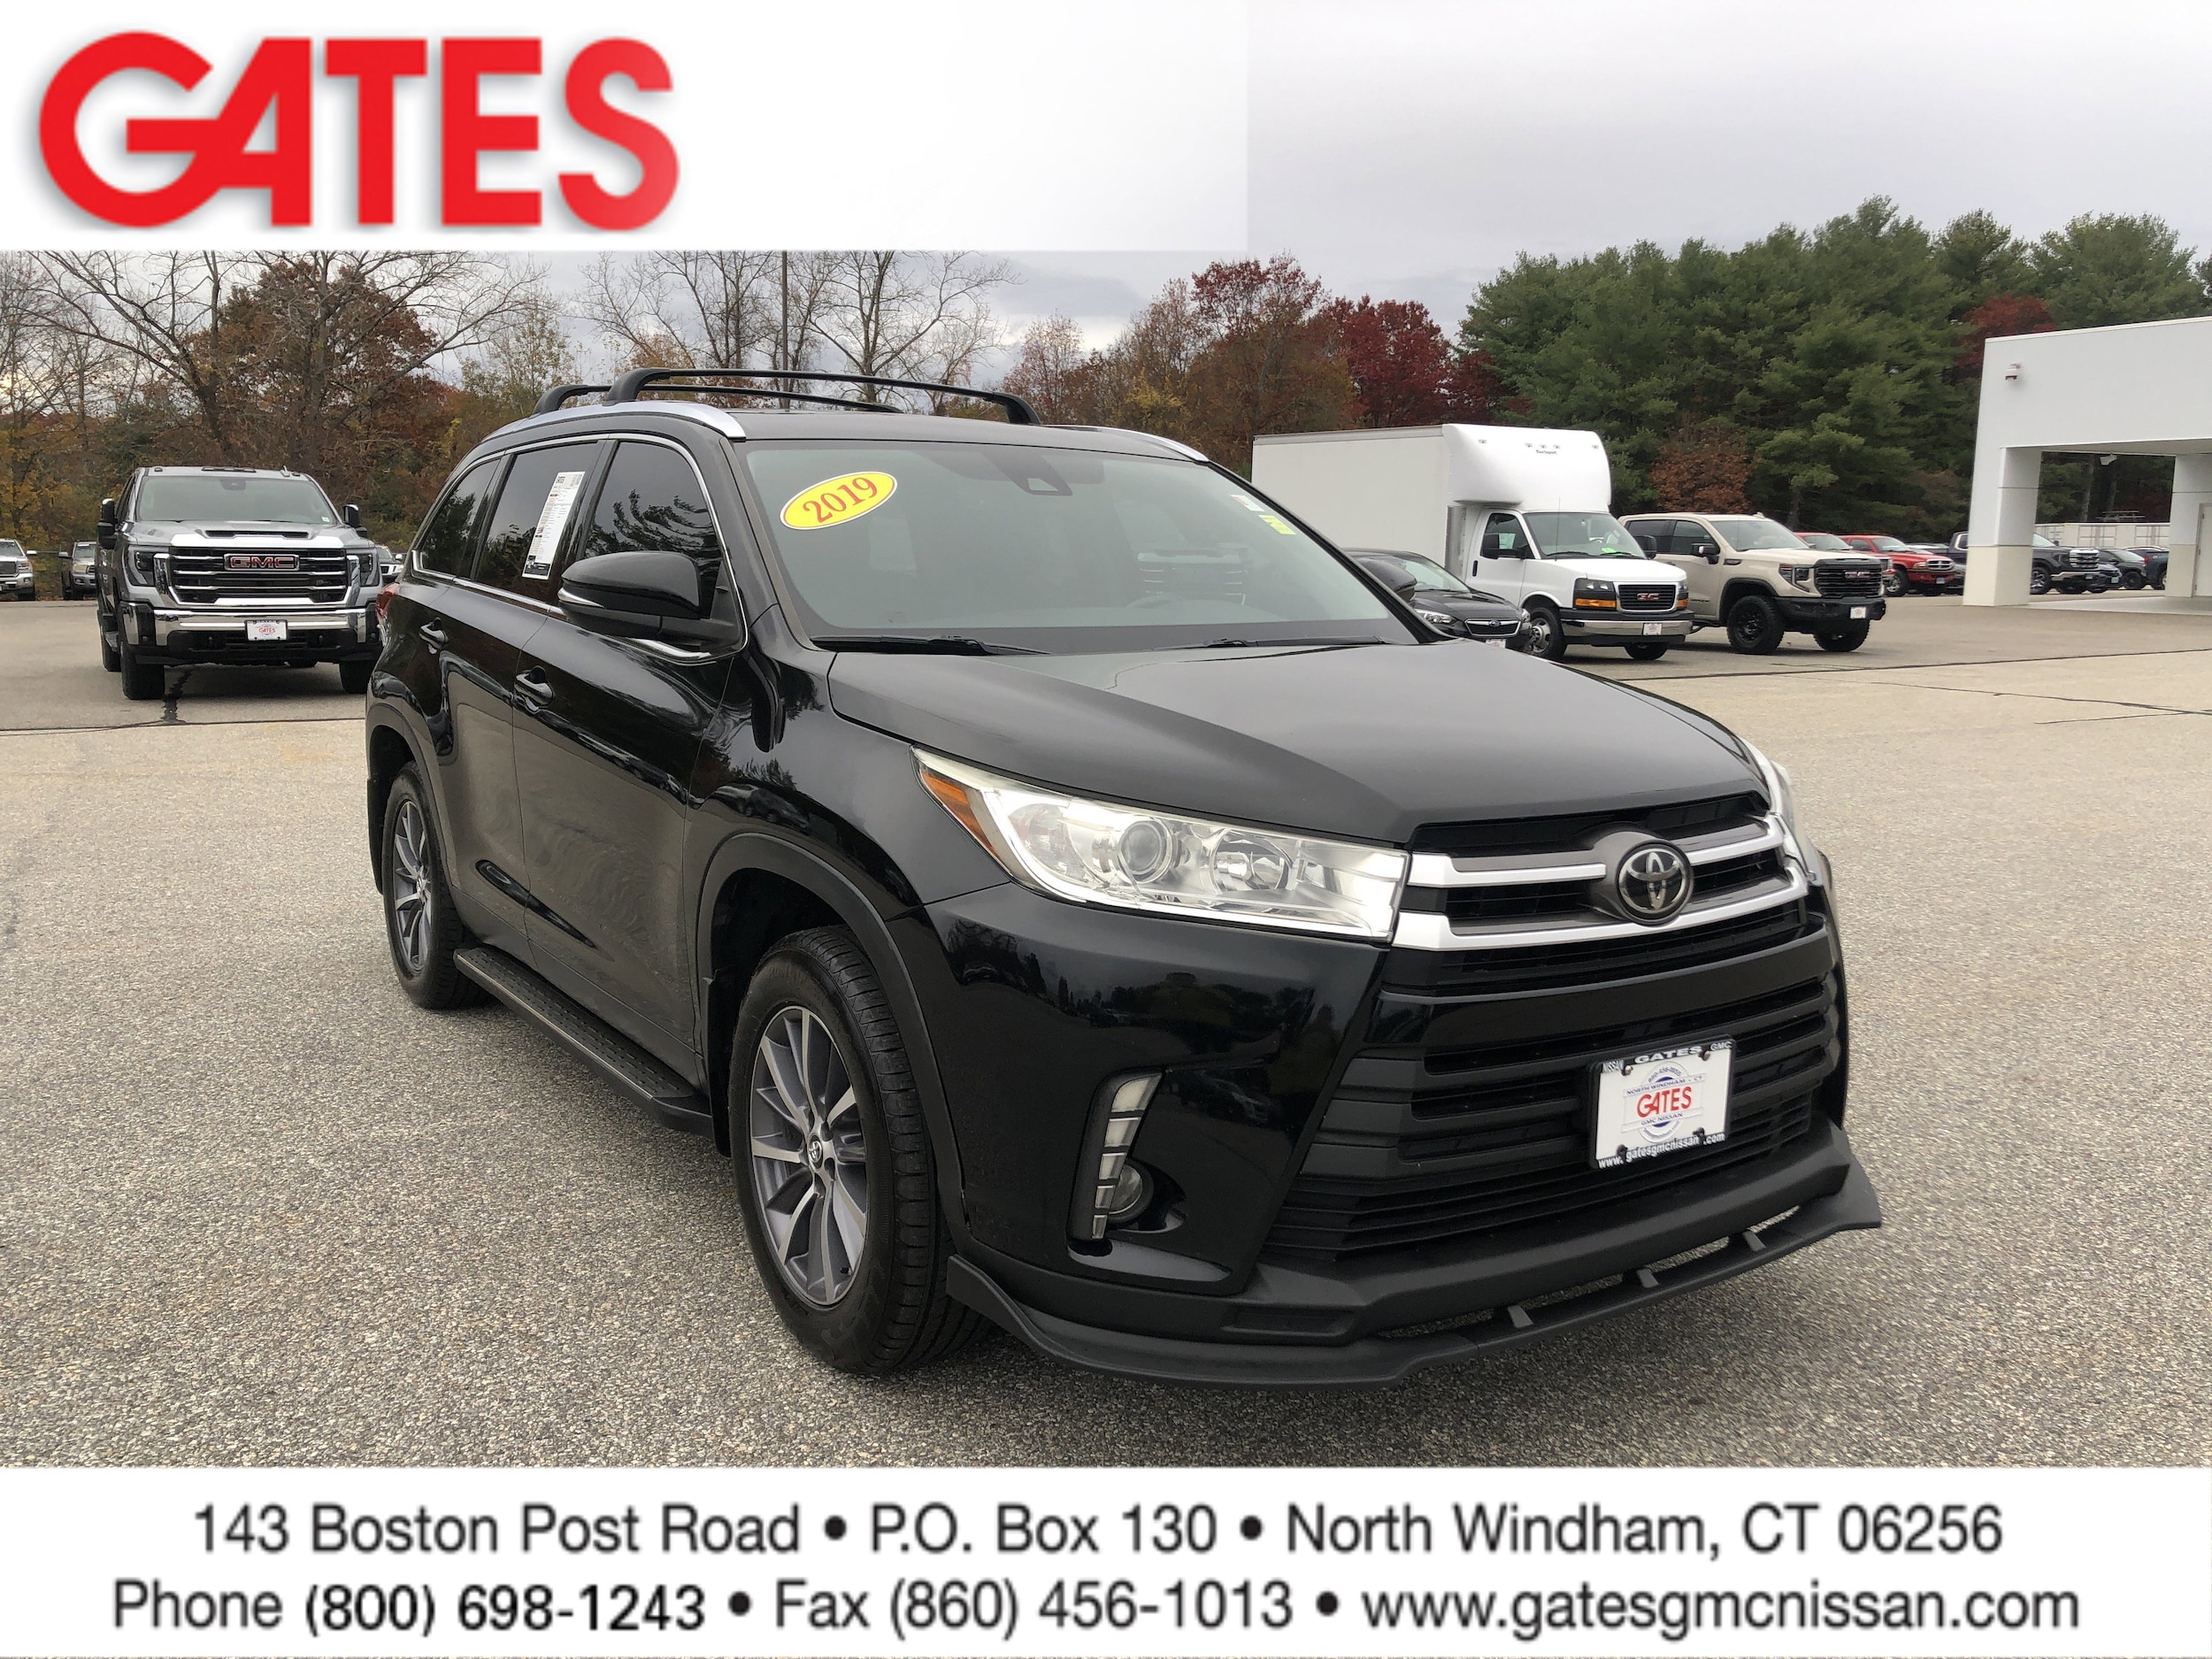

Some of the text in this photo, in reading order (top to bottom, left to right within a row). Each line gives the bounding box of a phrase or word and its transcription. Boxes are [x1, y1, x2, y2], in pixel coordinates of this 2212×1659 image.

[803, 477, 878, 523] 2019
[230, 557, 294, 569] GMC
[1634, 1046, 1703, 1063] GATES
[1710, 1041, 1733, 1052] GMC
[1626, 1086, 1650, 1095] NORTH
[1651, 1079, 1686, 1090] WINDHAM
[1637, 1087, 1692, 1118] GATES
